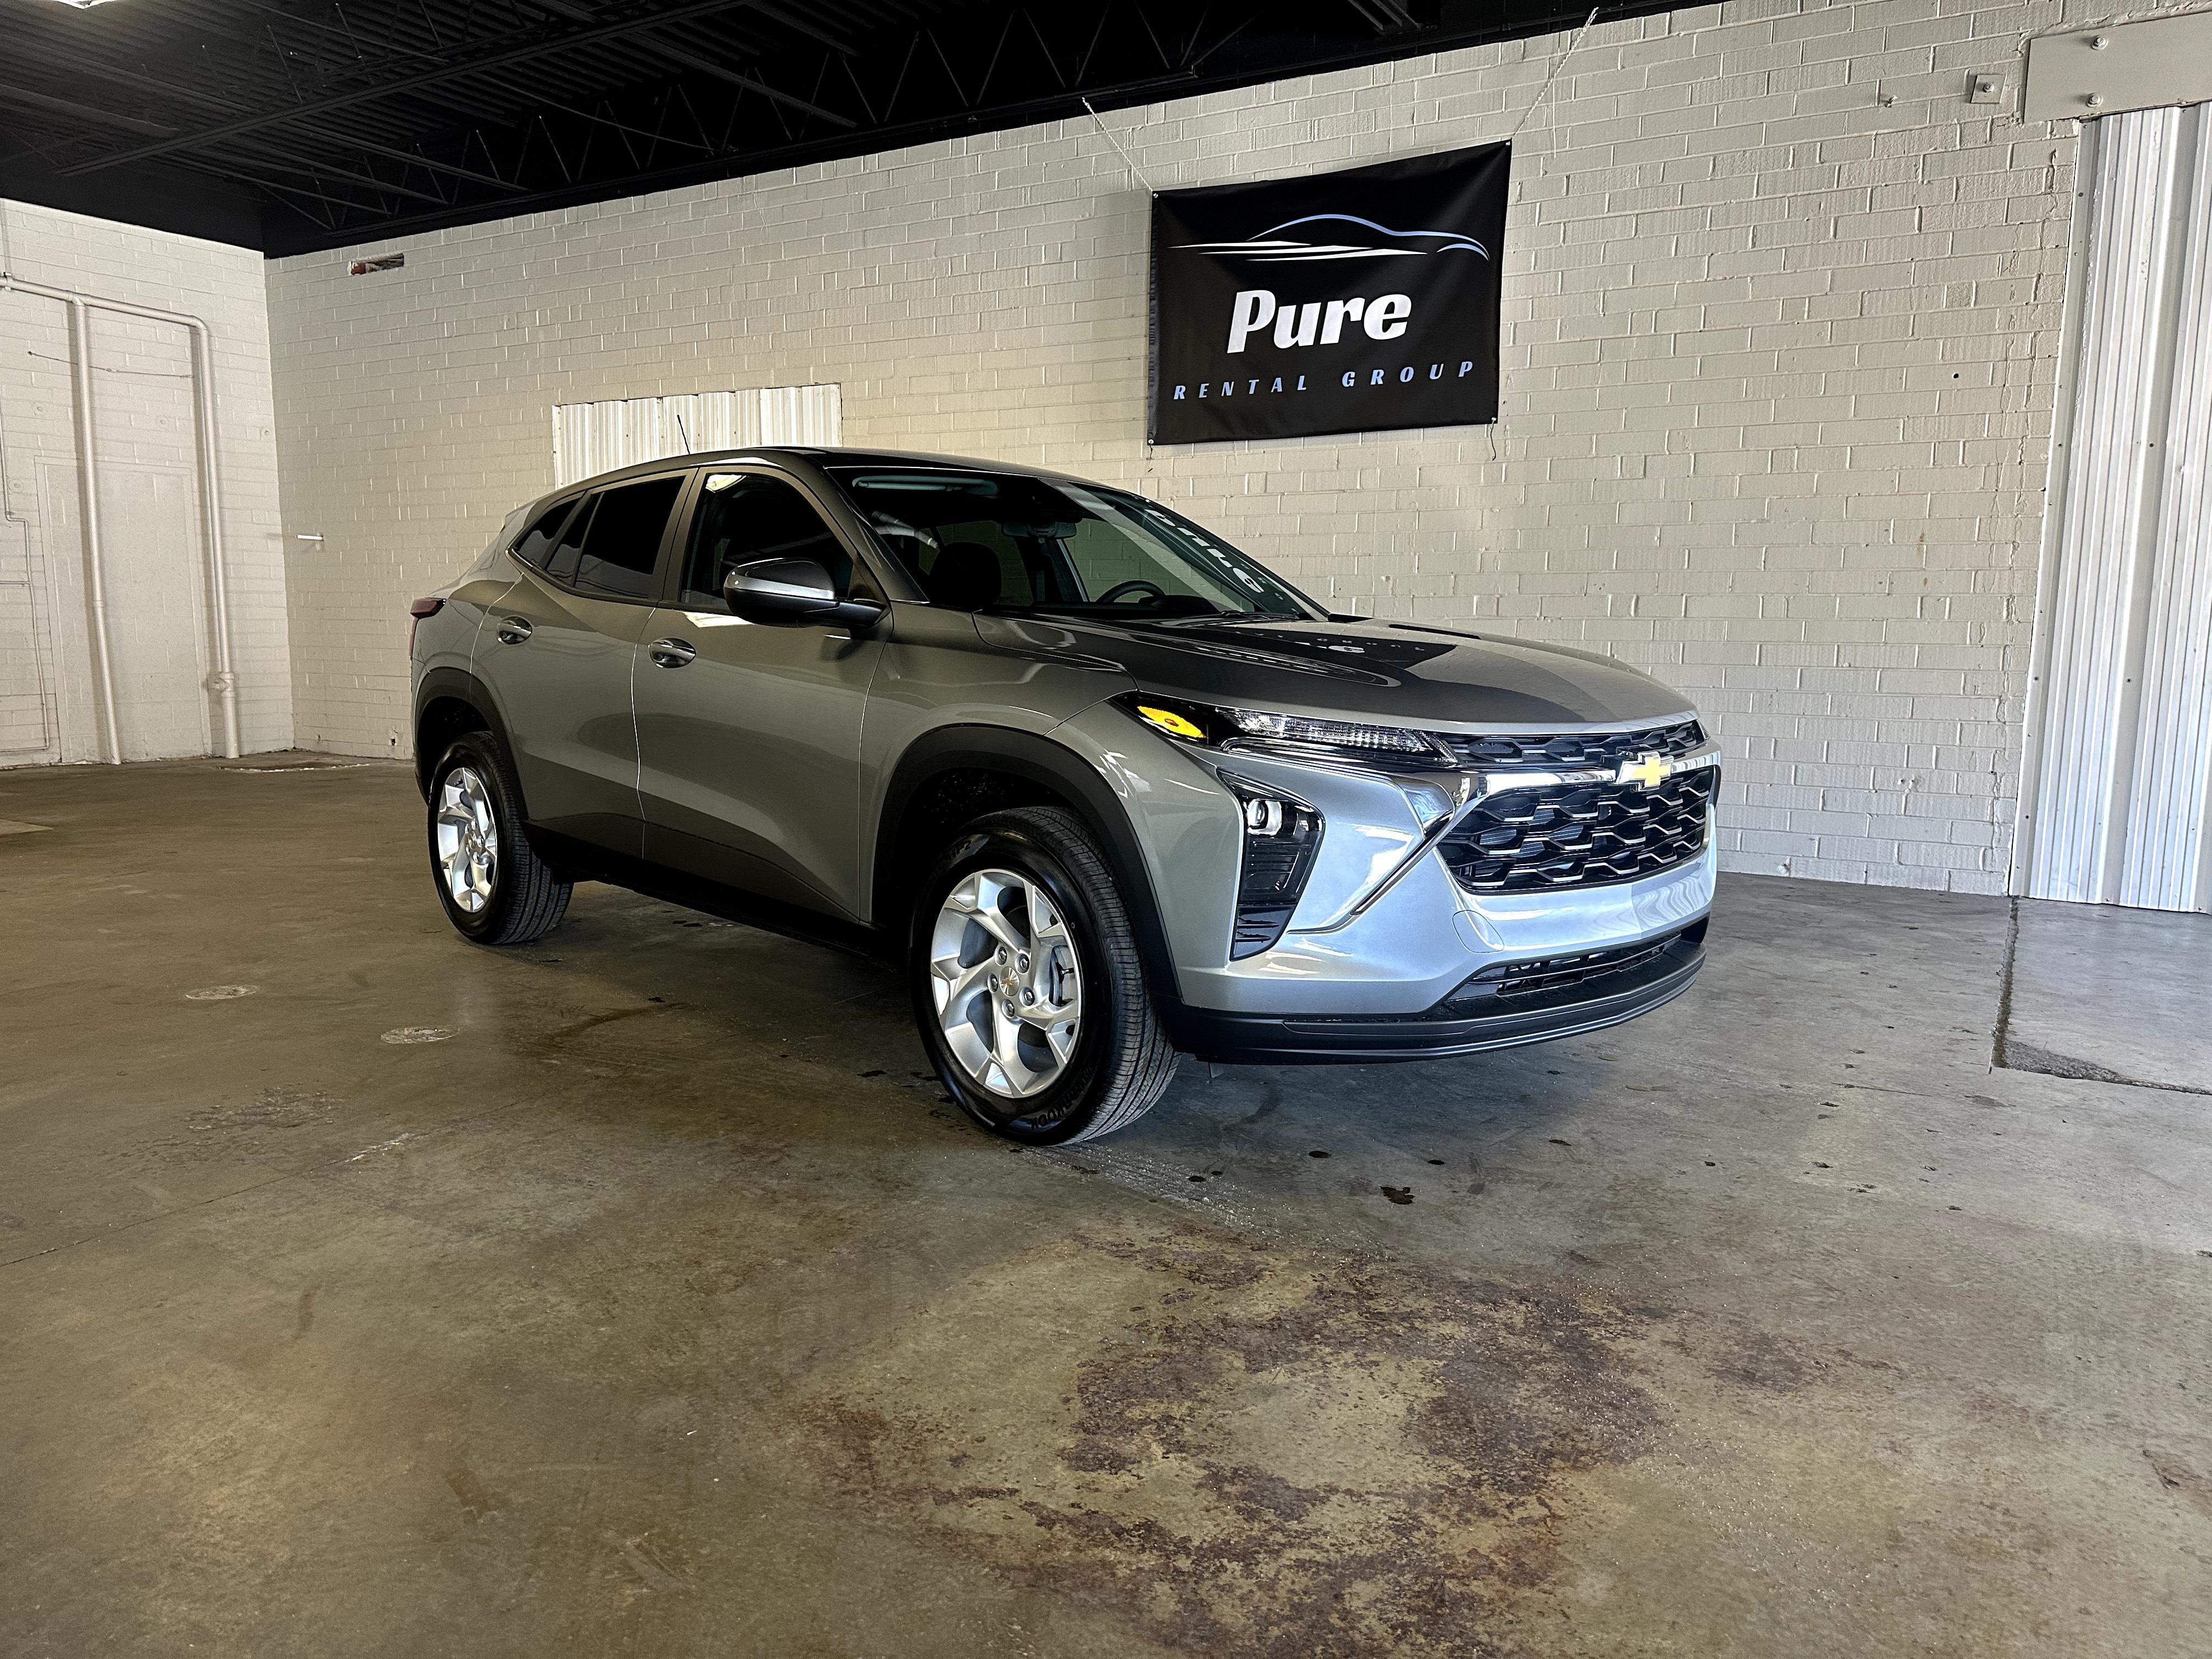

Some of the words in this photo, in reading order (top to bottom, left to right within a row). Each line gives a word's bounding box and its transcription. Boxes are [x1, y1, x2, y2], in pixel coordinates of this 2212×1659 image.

[1227, 290, 1412, 354] Pure
[1173, 375, 1307, 400] RENTAL
[1342, 361, 1474, 387] GROUP
